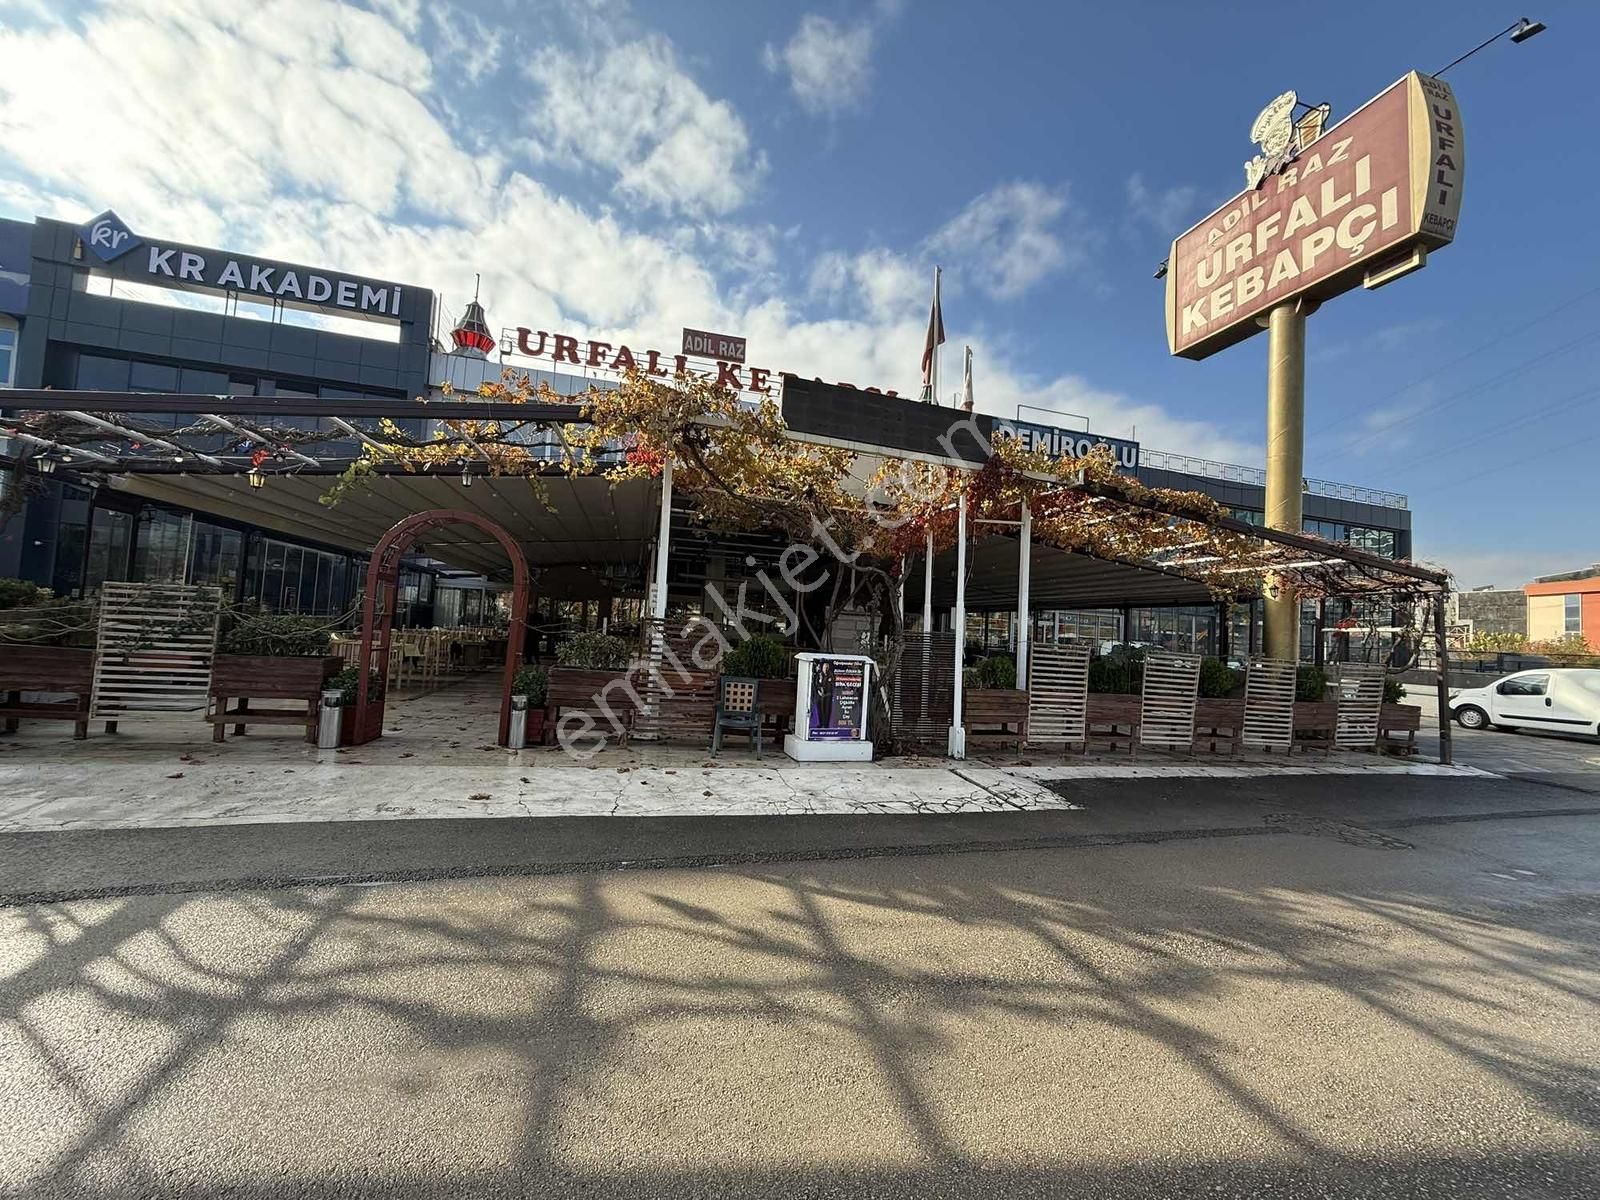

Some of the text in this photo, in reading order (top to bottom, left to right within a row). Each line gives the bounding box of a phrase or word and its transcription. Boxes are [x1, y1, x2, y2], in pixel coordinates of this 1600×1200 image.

[1207, 135, 1354, 247] ADİL RAZ
[1433, 104, 1456, 205] URFALI
[1181, 186, 1399, 336] KEBAPÇI
[1196, 154, 1372, 289] URFALI
[148, 246, 402, 316] KR AKADEMİ
[517, 327, 687, 377] URFALI
[684, 334, 745, 360] ADİL RAZ
